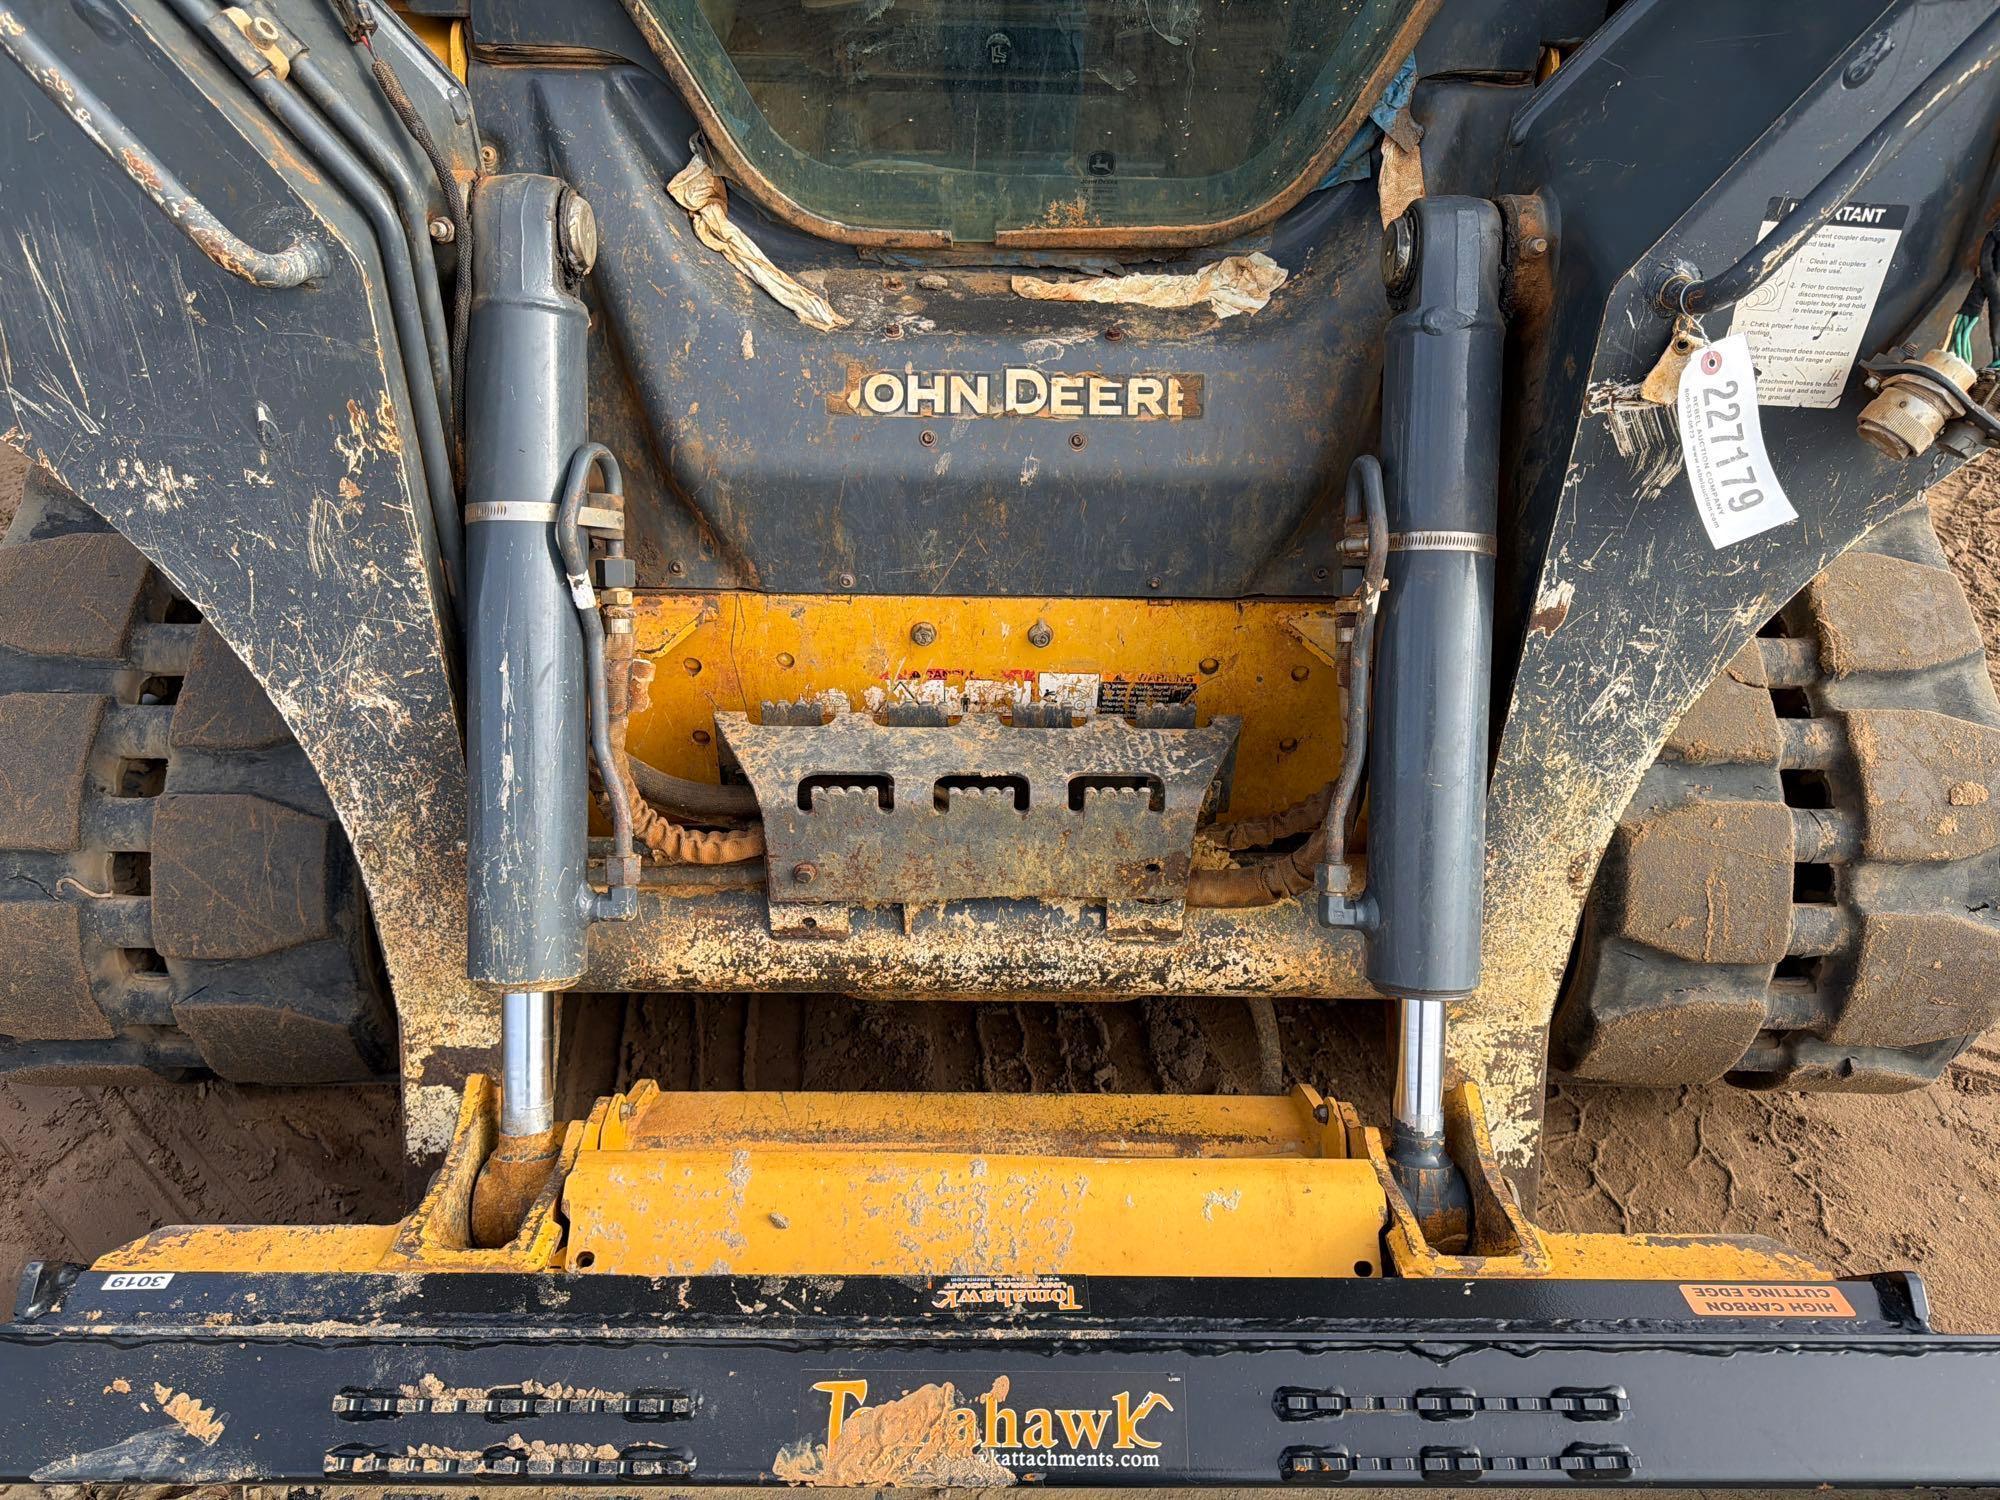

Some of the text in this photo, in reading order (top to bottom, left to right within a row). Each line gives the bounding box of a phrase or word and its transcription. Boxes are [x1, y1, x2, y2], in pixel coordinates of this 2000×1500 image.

[1789, 202, 1886, 223] ITANT
[1834, 234, 1860, 243] coupler
[1860, 235, 1886, 243] damage
[1818, 241, 1835, 249] leaks
[1809, 258, 1829, 266] Clean
[1829, 258, 1838, 266] all
[1838, 260, 1867, 268] couplers
[1770, 323, 1793, 331] proper
[1768, 355, 1793, 363] through
[1703, 380, 1764, 513] 227179
[1692, 396, 1726, 516] REBEL AUCTION COMPANY
[110, 1276, 166, 1288] 3019
[943, 1281, 1067, 1289] UNIVERSAL MOUNT
[931, 1285, 1084, 1311] Tomahawk
[1692, 1287, 1831, 1298] CUTTING EDGE
[1705, 1301, 1839, 1313] HIGH CARBON
[812, 1378, 1175, 1459] Tahawk
